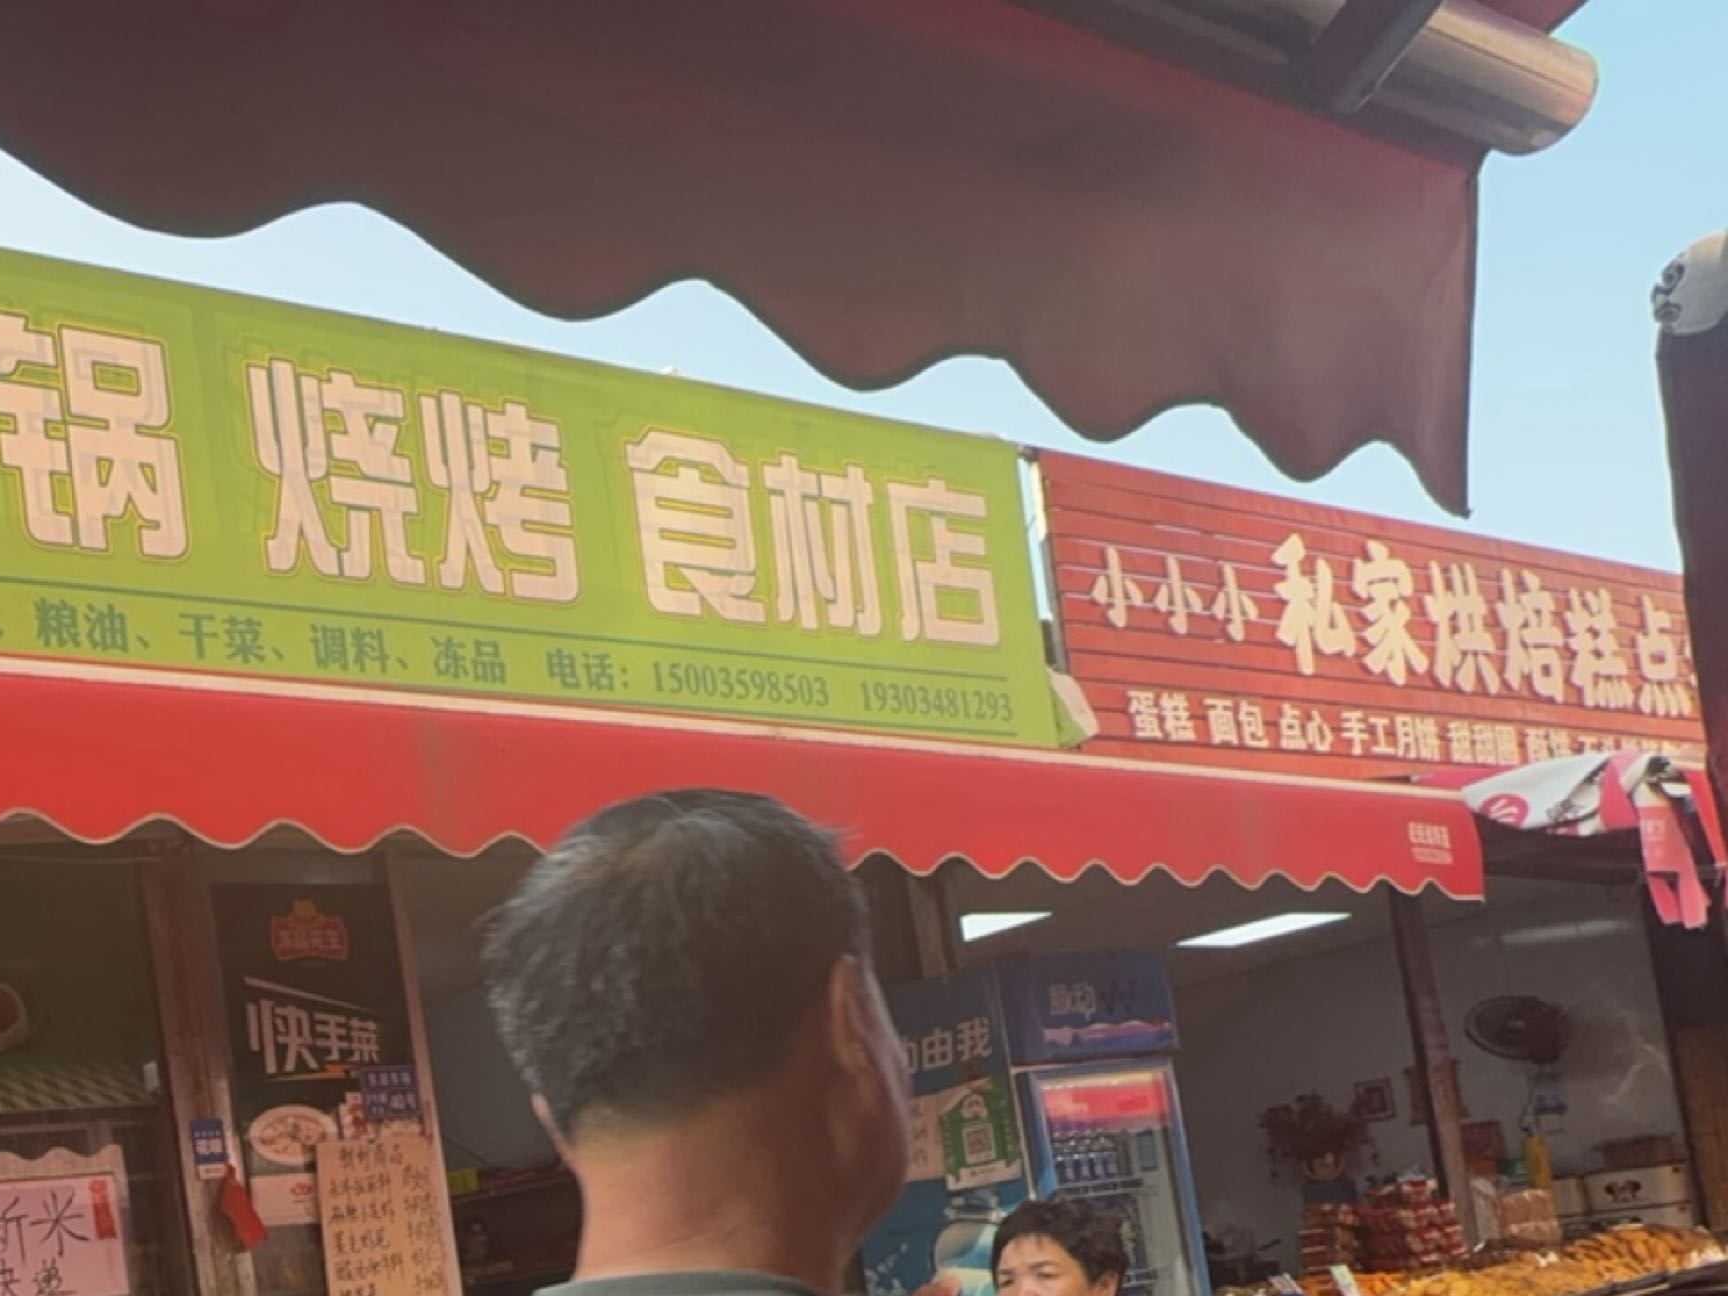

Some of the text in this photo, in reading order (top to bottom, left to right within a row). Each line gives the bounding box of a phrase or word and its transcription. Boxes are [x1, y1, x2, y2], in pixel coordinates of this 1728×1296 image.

[243, 356, 580, 604] 烧烤
[622, 428, 1001, 647] 食材店
[1092, 532, 1696, 716] 小小小 私家烘焙糕点
[862, 682, 1012, 722] 19303481293
[1127, 690, 1196, 740] 蛋糕
[1203, 697, 1269, 747] 面包
[1280, 702, 1333, 751] 点心
[1340, 710, 1440, 761] 手工月饼
[246, 1000, 379, 1073] 快手菜
